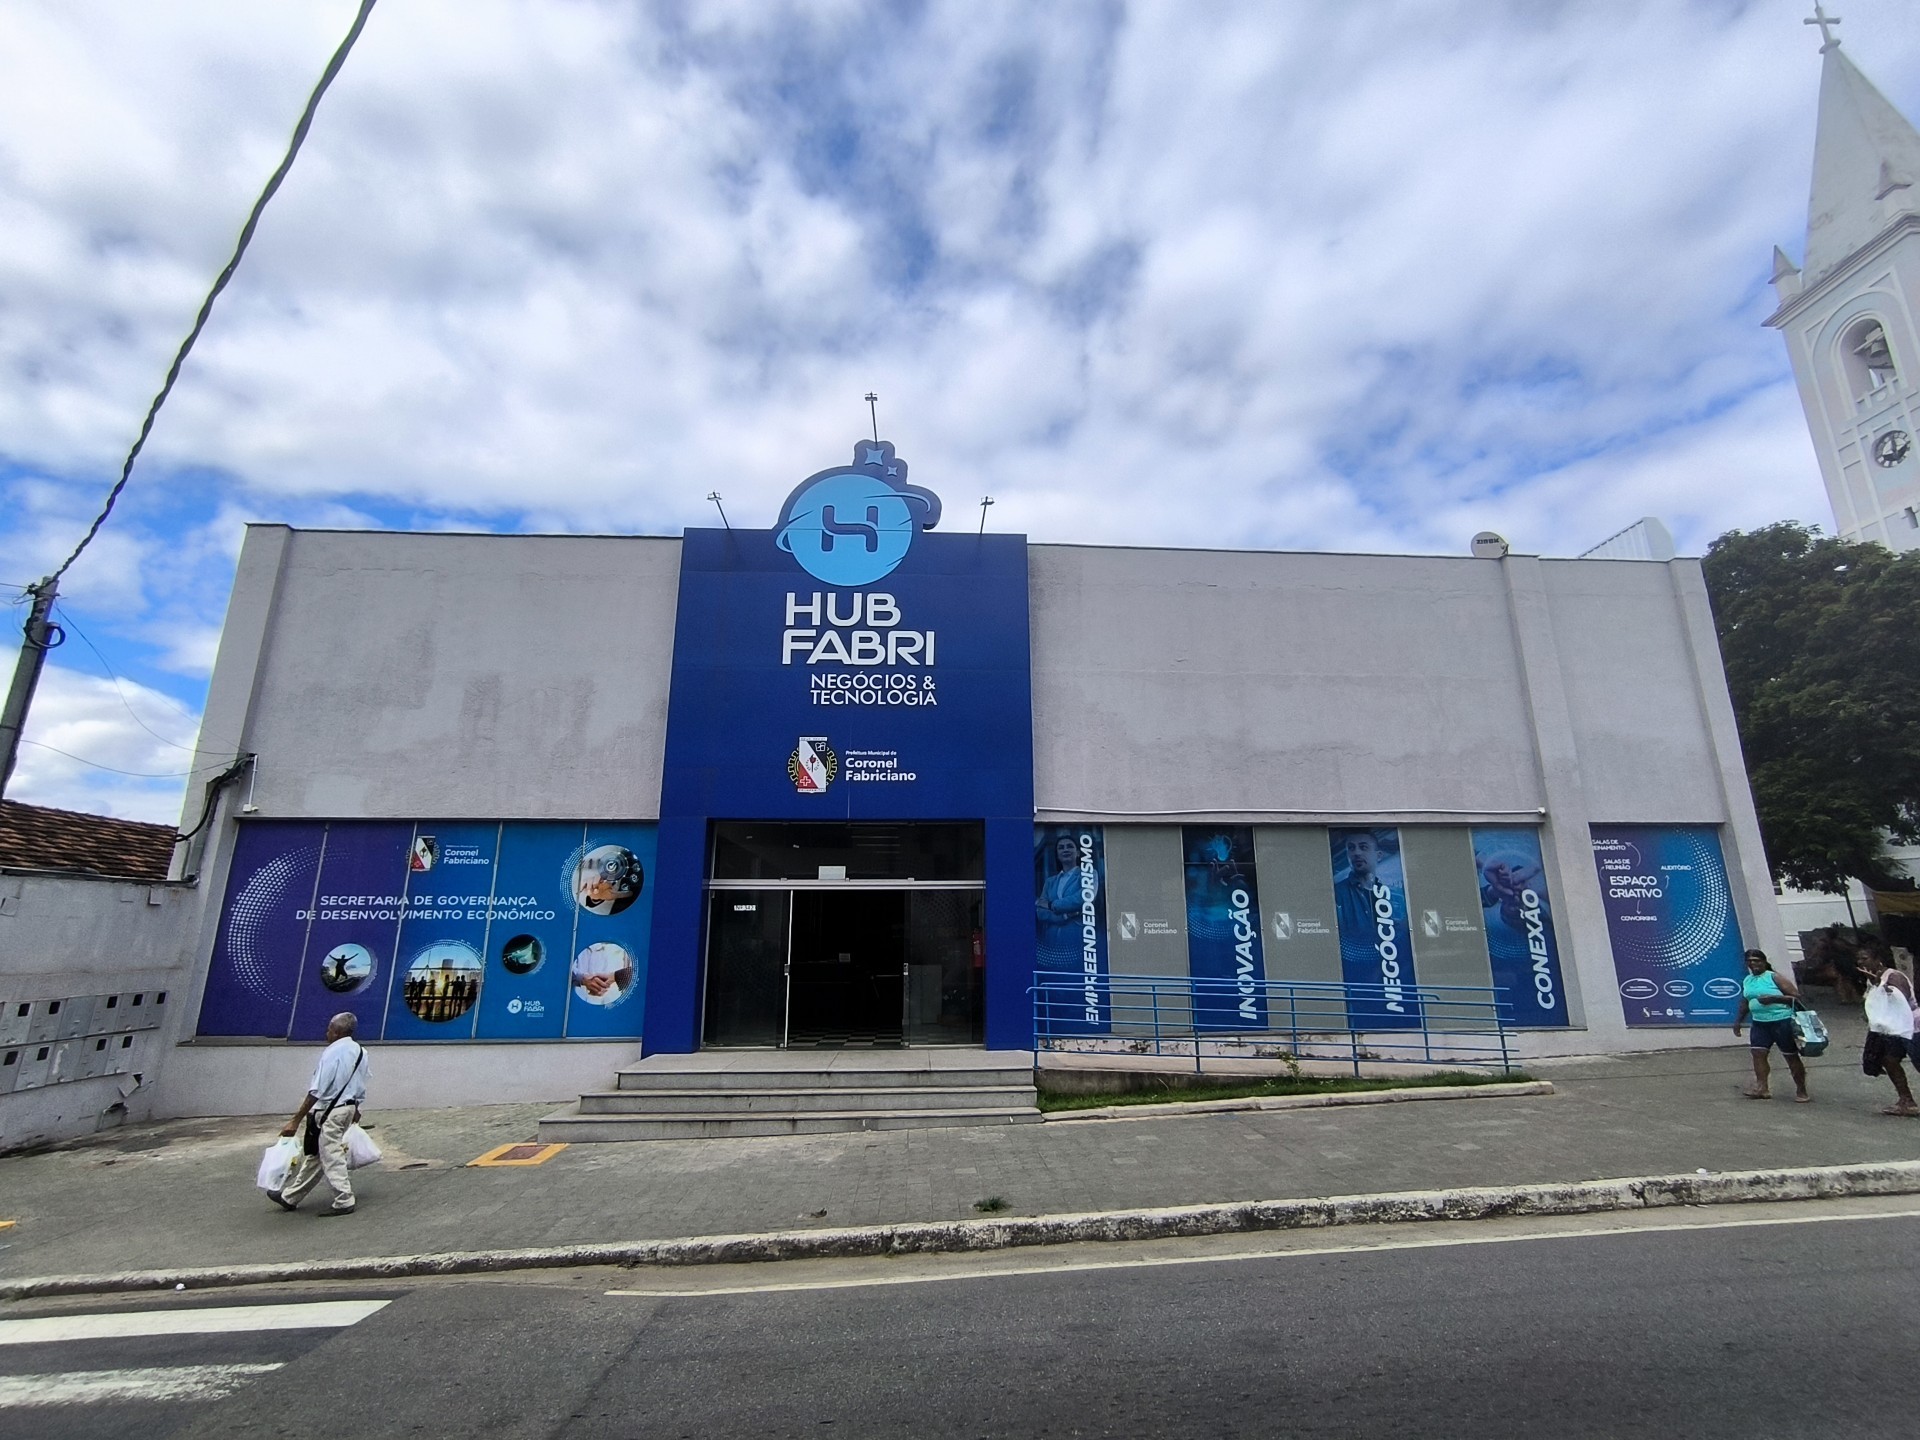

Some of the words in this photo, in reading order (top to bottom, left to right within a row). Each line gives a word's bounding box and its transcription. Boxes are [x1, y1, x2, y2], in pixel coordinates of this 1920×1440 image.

[785, 592, 902, 627] HUB
[782, 629, 935, 666] FABRI
[811, 671, 917, 690] NEGÓCIOS
[922, 675, 936, 690] &
[810, 690, 938, 706] TECNOLOGIA
[845, 757, 898, 768] Coronel
[845, 769, 917, 781] Fabriciano
[444, 848, 479, 857] Coronel
[443, 856, 490, 865] Fabriciano
[1609, 876, 1657, 887] ESPAÇO
[1609, 888, 1663, 898] CRIATIVO
[320, 895, 410, 906] SECRETARIA
[414, 895, 434, 906] DE
[437, 895, 538, 908] GOVERNANÇA
[295, 910, 317, 920] DE
[320, 910, 463, 920] DESENVOLVIMENTO
[466, 907, 556, 921] ECONÔMICO
[1228, 888, 1258, 1021] INOVAÇÃO
[1373, 884, 1405, 1014] NEGÓCIOS
[1520, 888, 1556, 1010] CONEXÃO
